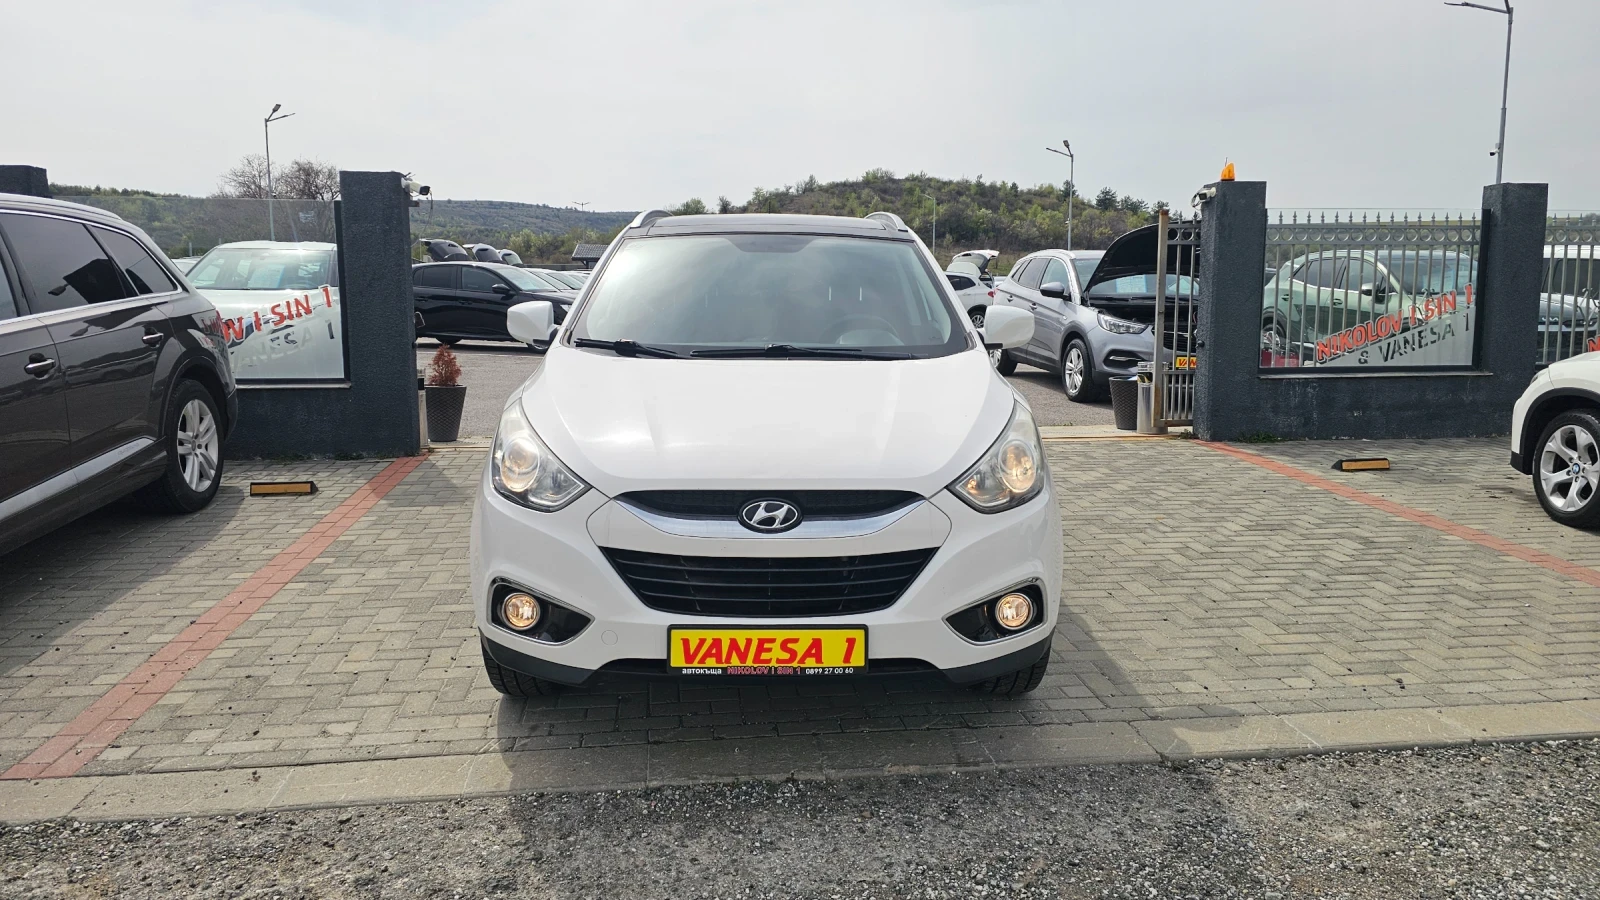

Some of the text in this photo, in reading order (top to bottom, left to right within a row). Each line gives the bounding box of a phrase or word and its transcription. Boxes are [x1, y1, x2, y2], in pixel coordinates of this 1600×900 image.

[270, 294, 313, 328] SIN
[322, 286, 333, 308] 1
[1316, 283, 1473, 361] NIKOLOV I SIN 1
[1378, 323, 1455, 362] VANESA
[680, 637, 857, 665] VANESA 1
[727, 666, 769, 675] NIKOLOV
[776, 666, 794, 674] SIN
